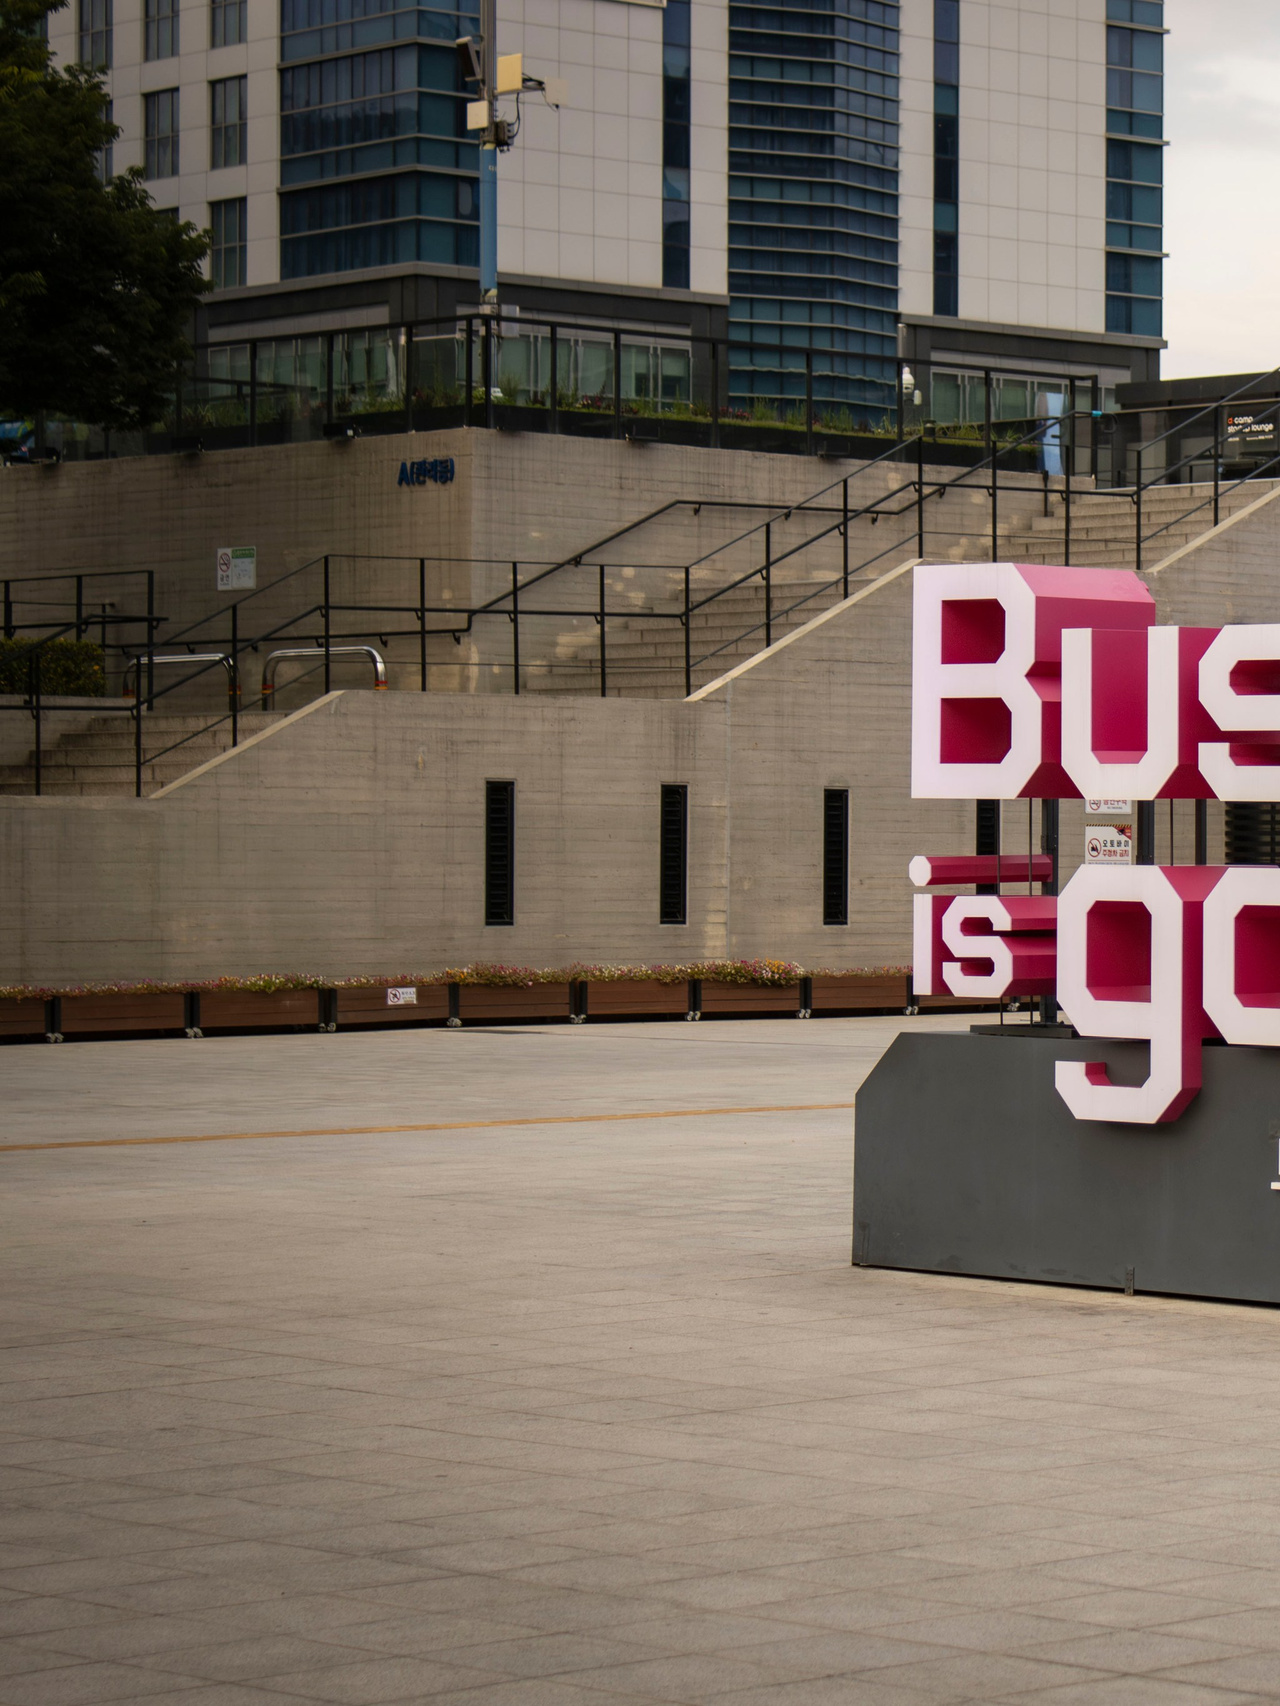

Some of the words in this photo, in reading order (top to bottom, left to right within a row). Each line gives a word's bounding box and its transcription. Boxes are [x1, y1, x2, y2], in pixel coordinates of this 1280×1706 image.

[1251, 423, 1274, 432] lounge
[1102, 839, 1129, 848] 오토바이
[1119, 849, 1129, 857] 금지
[909, 855, 1014, 998] is
